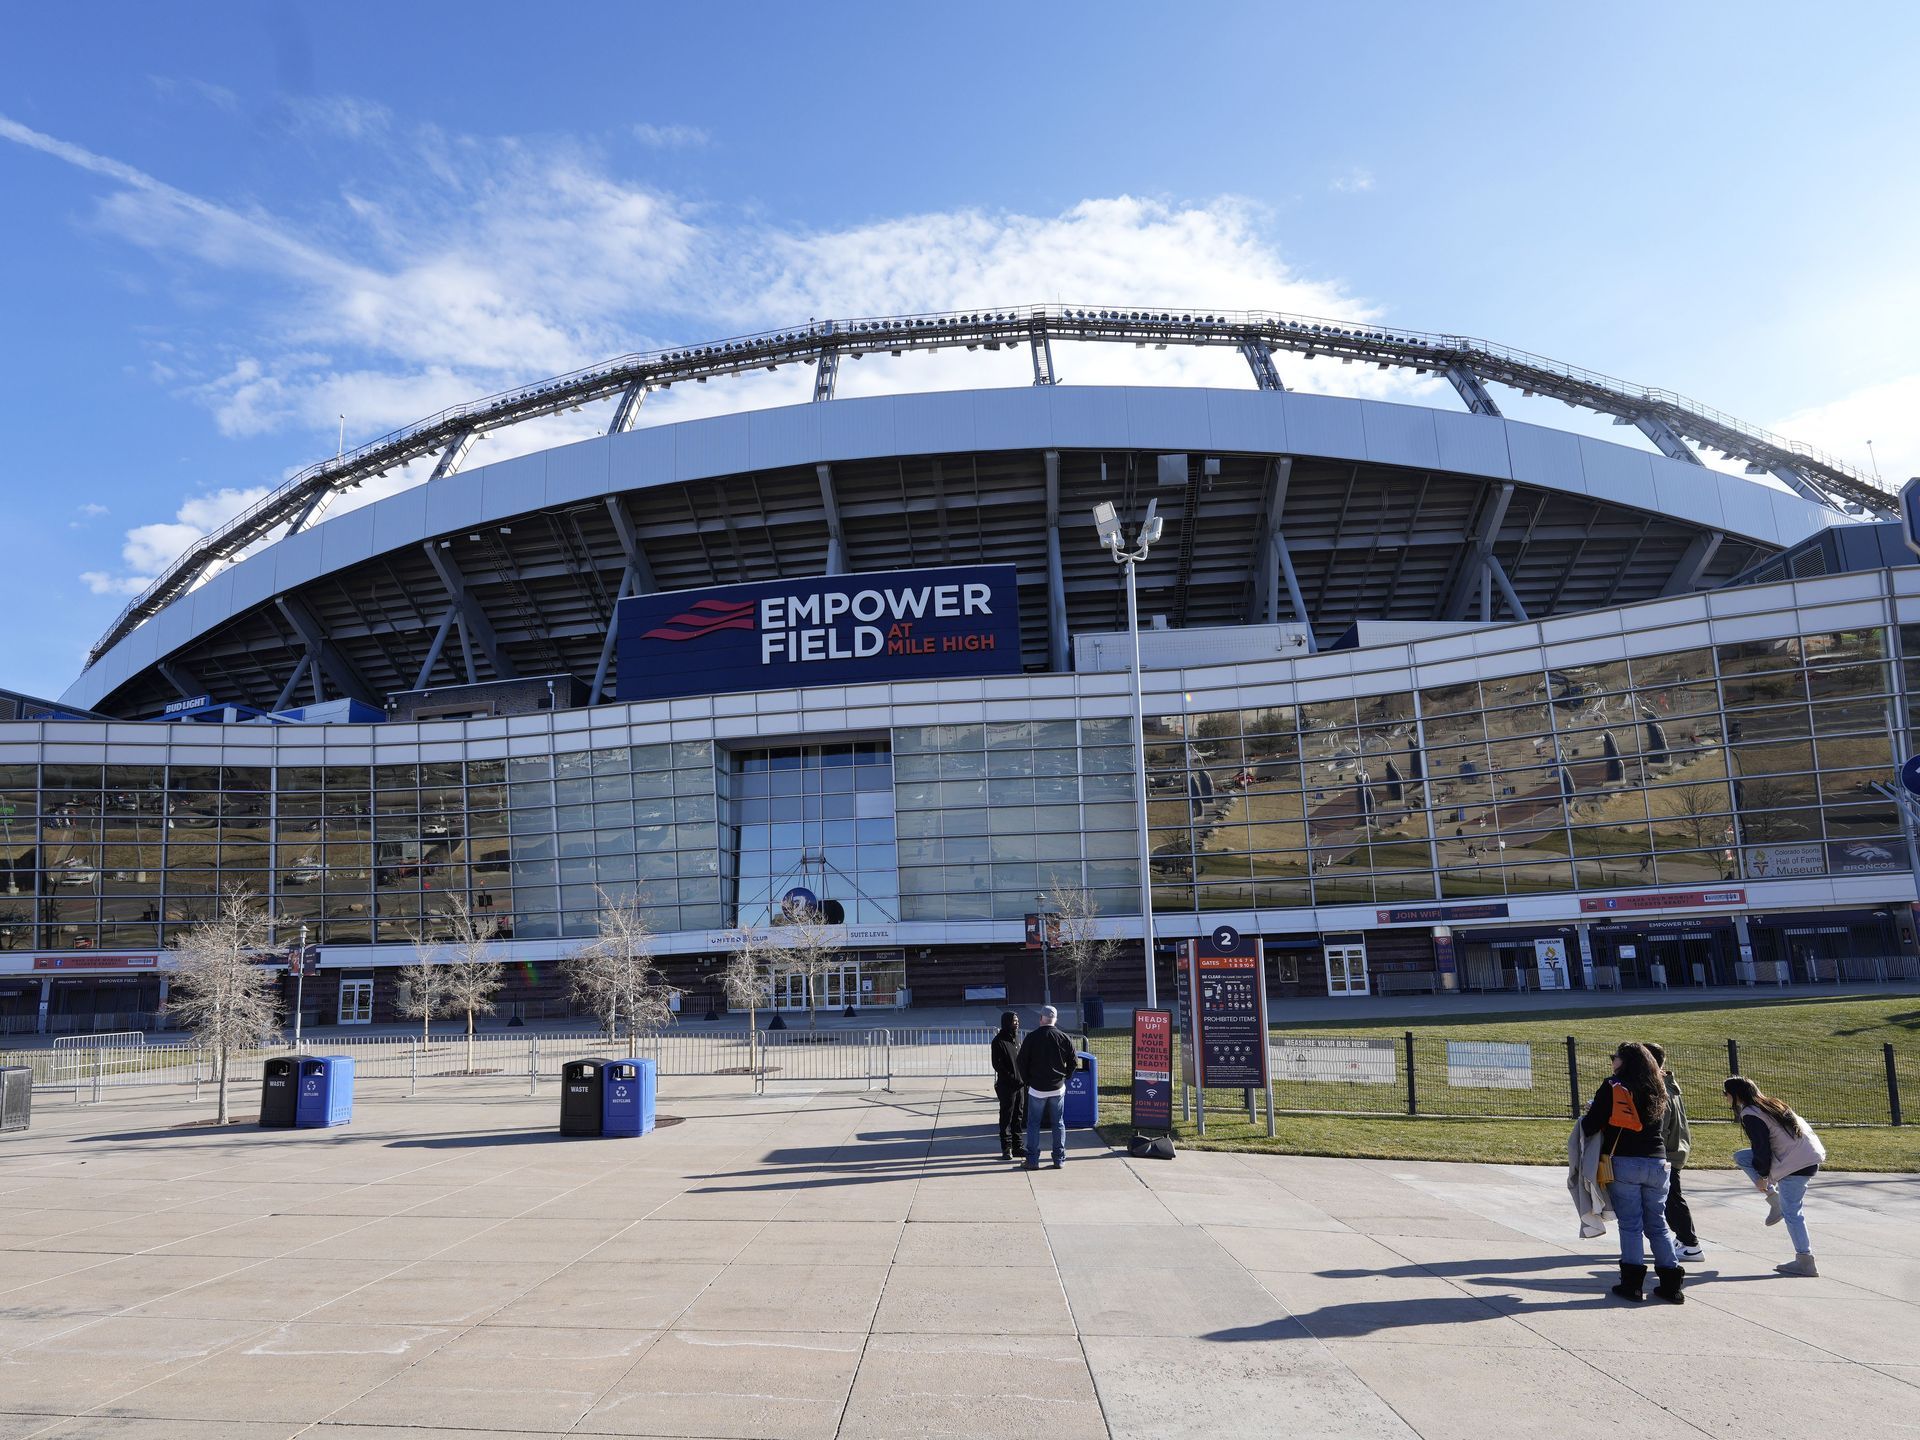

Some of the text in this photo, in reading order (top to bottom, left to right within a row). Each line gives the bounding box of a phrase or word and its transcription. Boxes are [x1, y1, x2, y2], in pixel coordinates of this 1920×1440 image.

[761, 583, 993, 629] EMPOWER
[887, 622, 913, 639] AT
[761, 625, 884, 665] FIELD
[887, 633, 995, 655] MILE HIGH
[166, 697, 206, 713] BUD LIGHT
[1775, 856, 1821, 865] Hall of Fame
[1776, 865, 1824, 875] Museum
[1843, 862, 1896, 871] BRONCOS
[1396, 910, 1440, 919] JOIN WIFI
[1220, 932, 1232, 945] 2
[1138, 1015, 1168, 1023] HEADS
[1284, 1039, 1316, 1047] MEASURE
[1336, 1040, 1350, 1048] BAG
[1137, 1046, 1168, 1054] MOBILE
[1136, 1053, 1169, 1061] TICKETS
